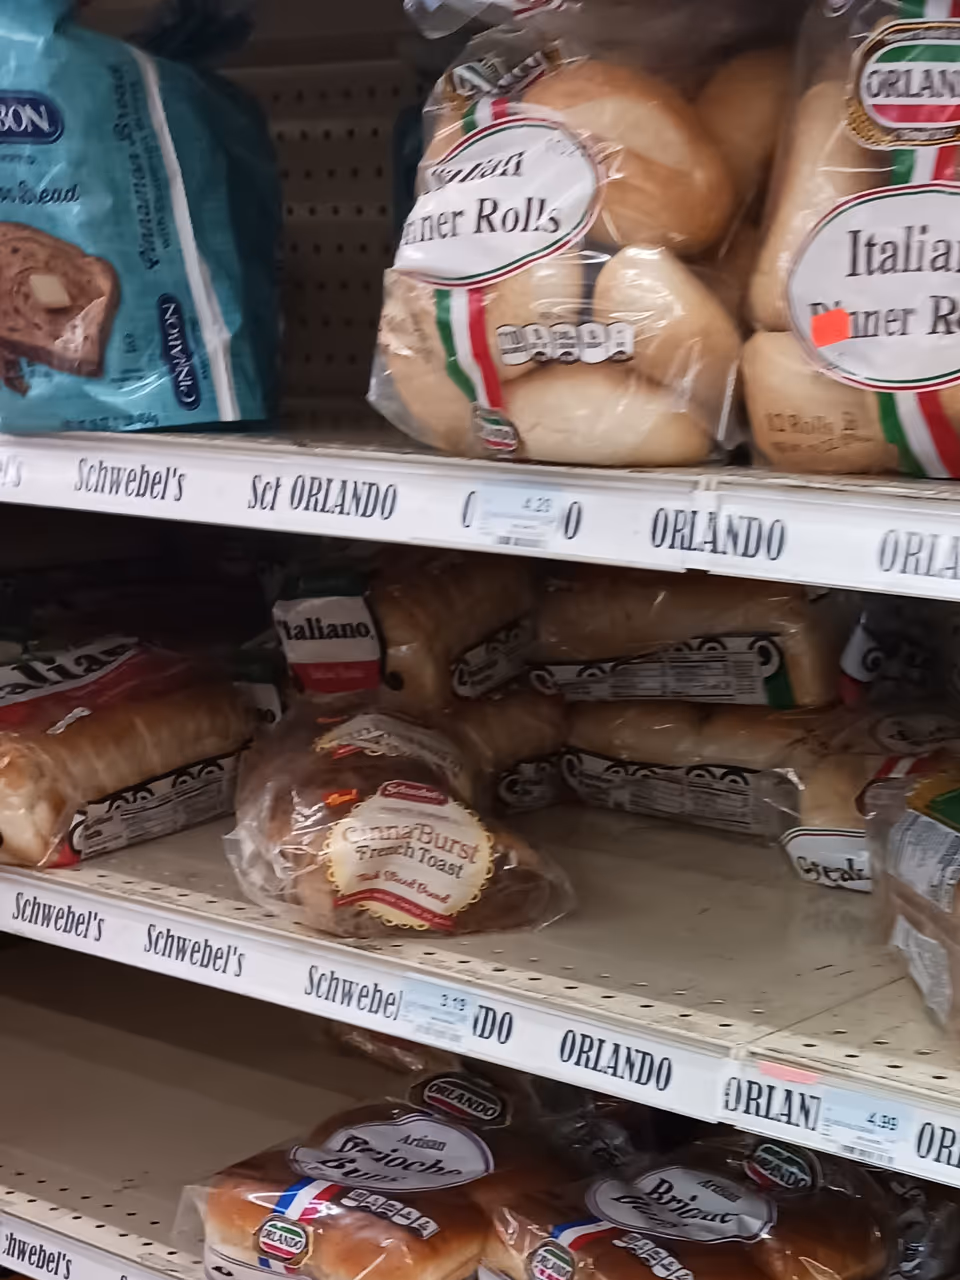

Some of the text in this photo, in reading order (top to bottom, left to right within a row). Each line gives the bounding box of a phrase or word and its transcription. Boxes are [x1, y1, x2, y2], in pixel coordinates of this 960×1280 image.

[473, 196, 561, 234] Rolls
[74, 457, 186, 502] Schwebel's
[290, 475, 398, 521] ORLANDO
[651, 507, 788, 561] ORLANDO
[356, 841, 464, 878] French Toast
[12, 892, 105, 942] Schwebel's
[143, 924, 245, 978] Schwebel's
[560, 1029, 673, 1092] ORLANDO
[427, 1081, 500, 1119] ORLANDO
[724, 1076, 822, 1131] ORLAN
[866, 1111, 899, 1131] 4.99
[336, 1134, 463, 1178] Brioche
[399, 1133, 447, 1152] Artisan
[698, 1179, 743, 1203] Artisan
[262, 1228, 306, 1250] ORLANDO
